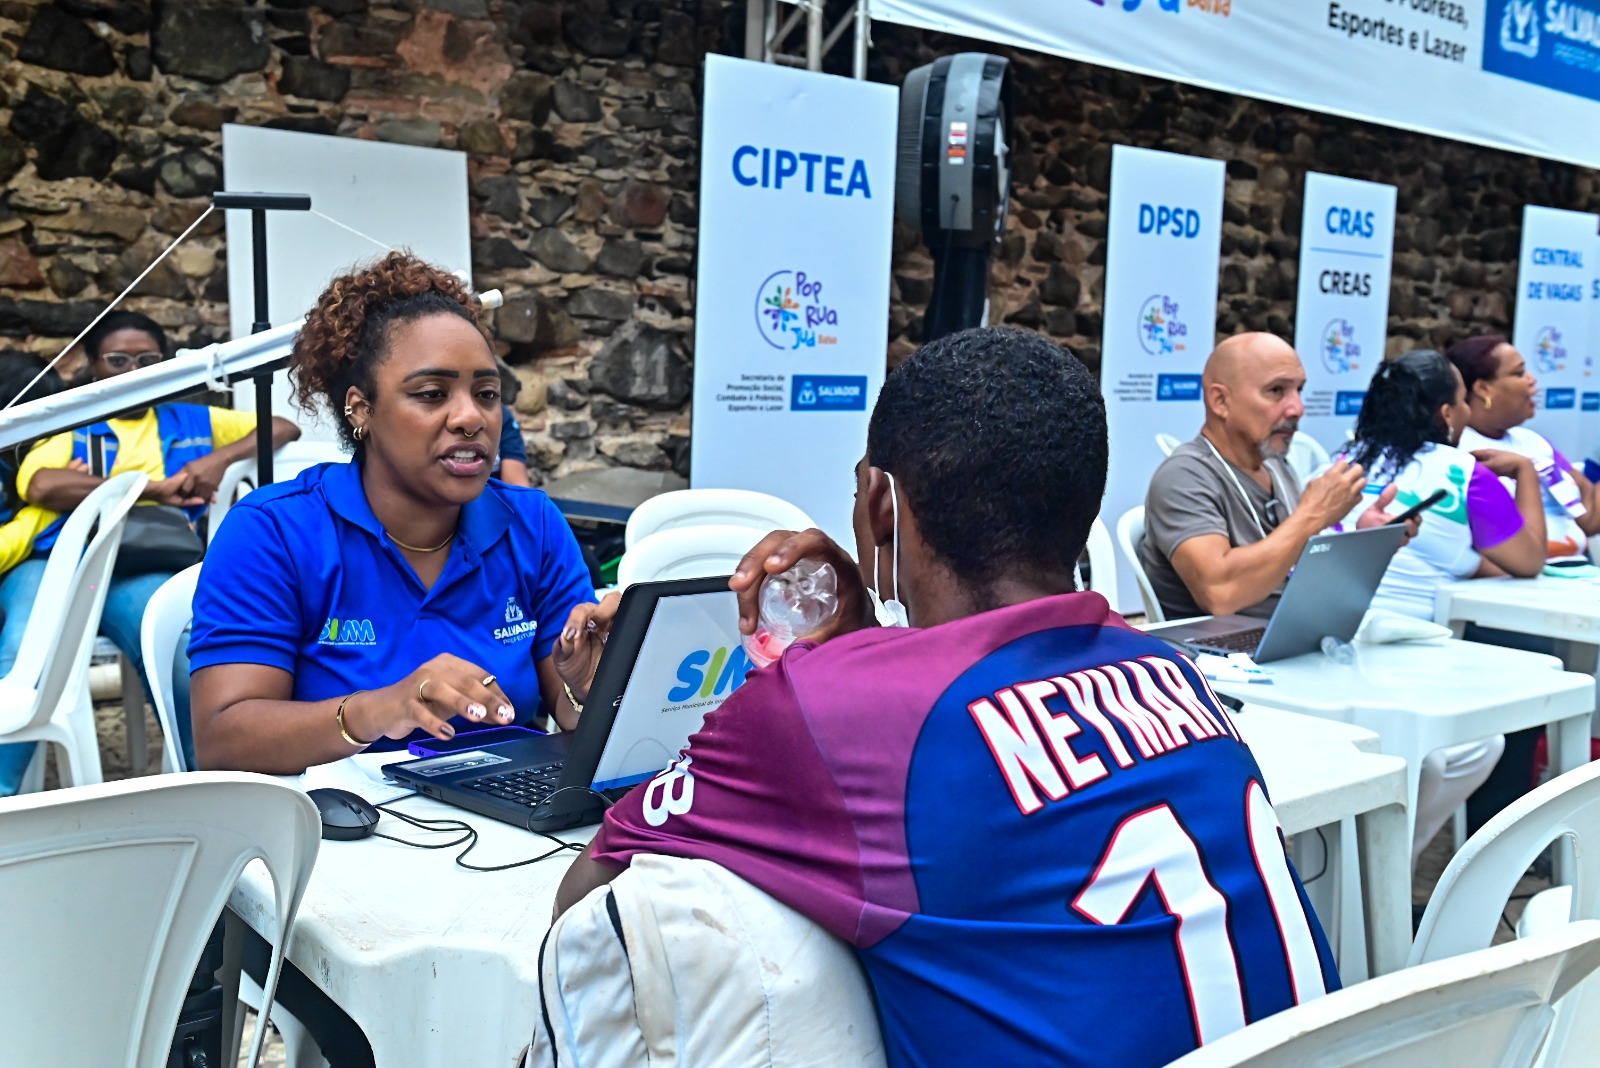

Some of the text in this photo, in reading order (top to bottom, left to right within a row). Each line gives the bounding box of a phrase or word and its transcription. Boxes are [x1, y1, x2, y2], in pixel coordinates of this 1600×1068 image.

[1399, 0, 1469, 30] obreza,
[1327, 2, 1468, 63] Esportes e Lazer
[732, 144, 872, 199] CIPTEA
[1138, 203, 1201, 239] DPSD
[1325, 206, 1375, 239] CRAS
[1532, 246, 1583, 269] CENTRAL
[796, 271, 822, 304] Pop
[1319, 269, 1373, 298] CREAS
[667, 645, 758, 702] SIM
[967, 655, 1229, 816] NEYMAR
